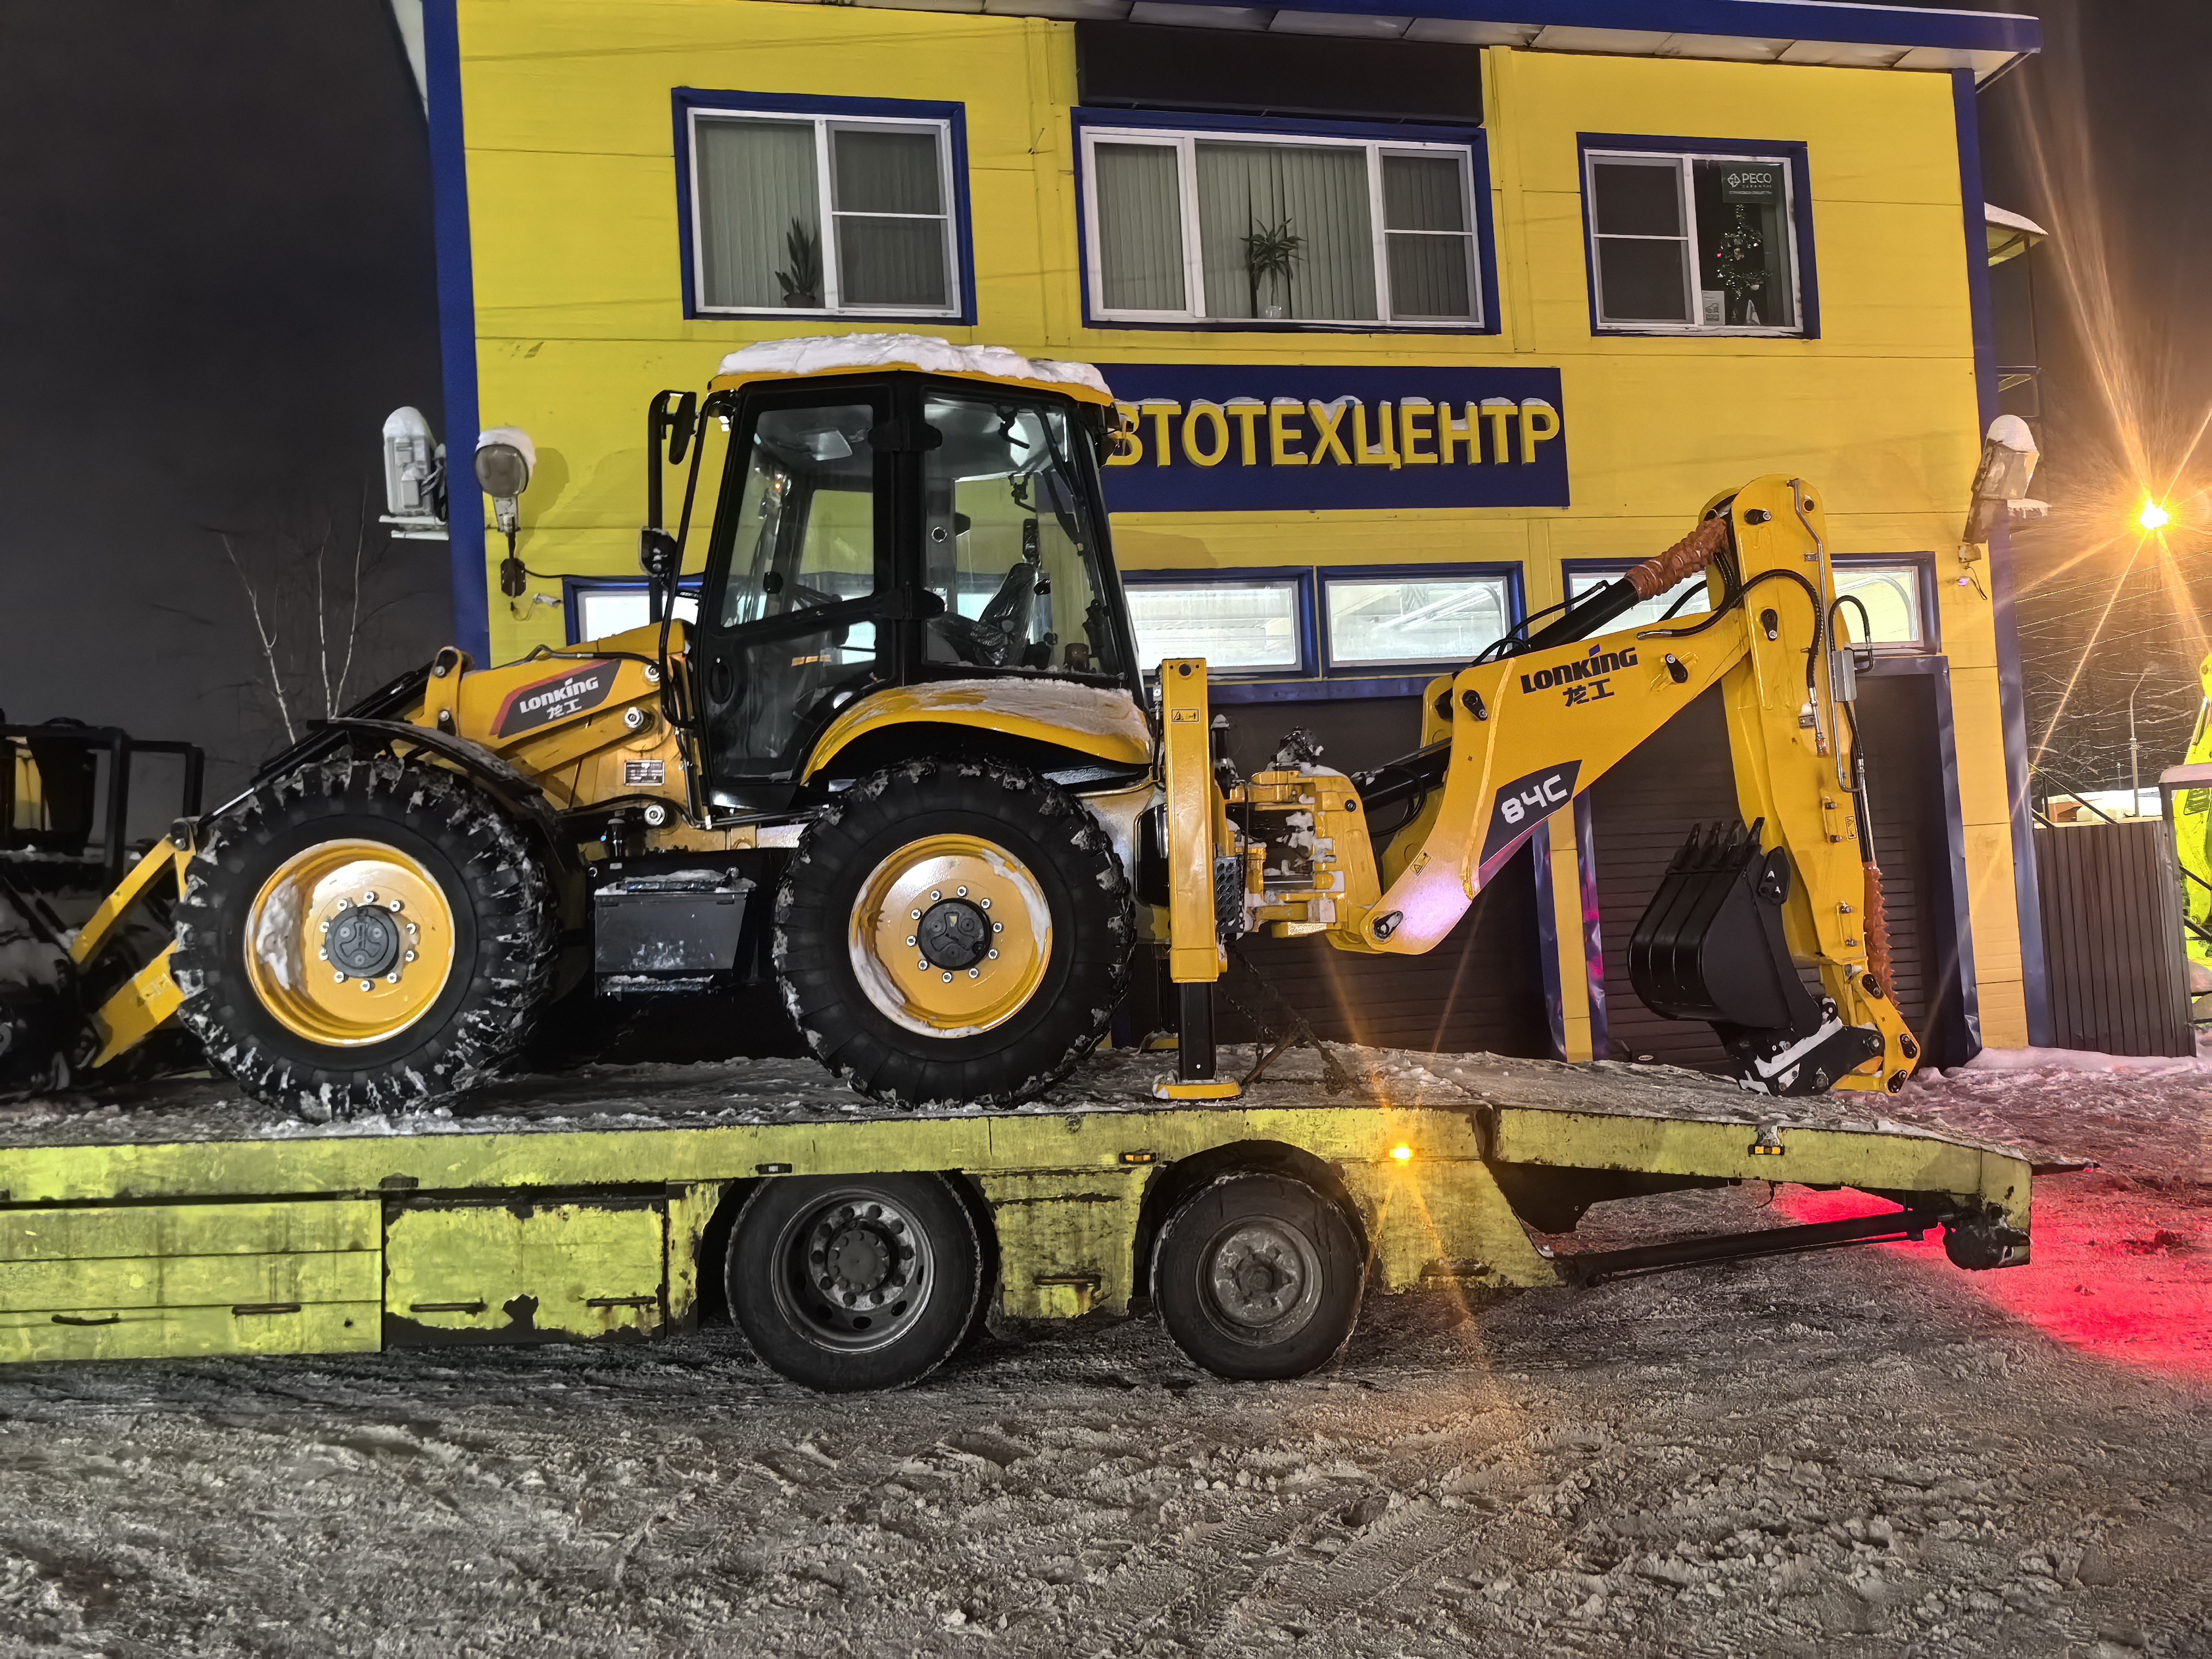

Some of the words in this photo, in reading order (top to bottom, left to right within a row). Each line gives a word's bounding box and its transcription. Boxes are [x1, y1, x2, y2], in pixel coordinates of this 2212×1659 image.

[1105, 403, 1561, 470] ВТОТЕХЦЕНТР
[546, 698, 583, 720] 龙工
[1562, 678, 1615, 707] 龙工
[1501, 774, 1568, 825] 84C
